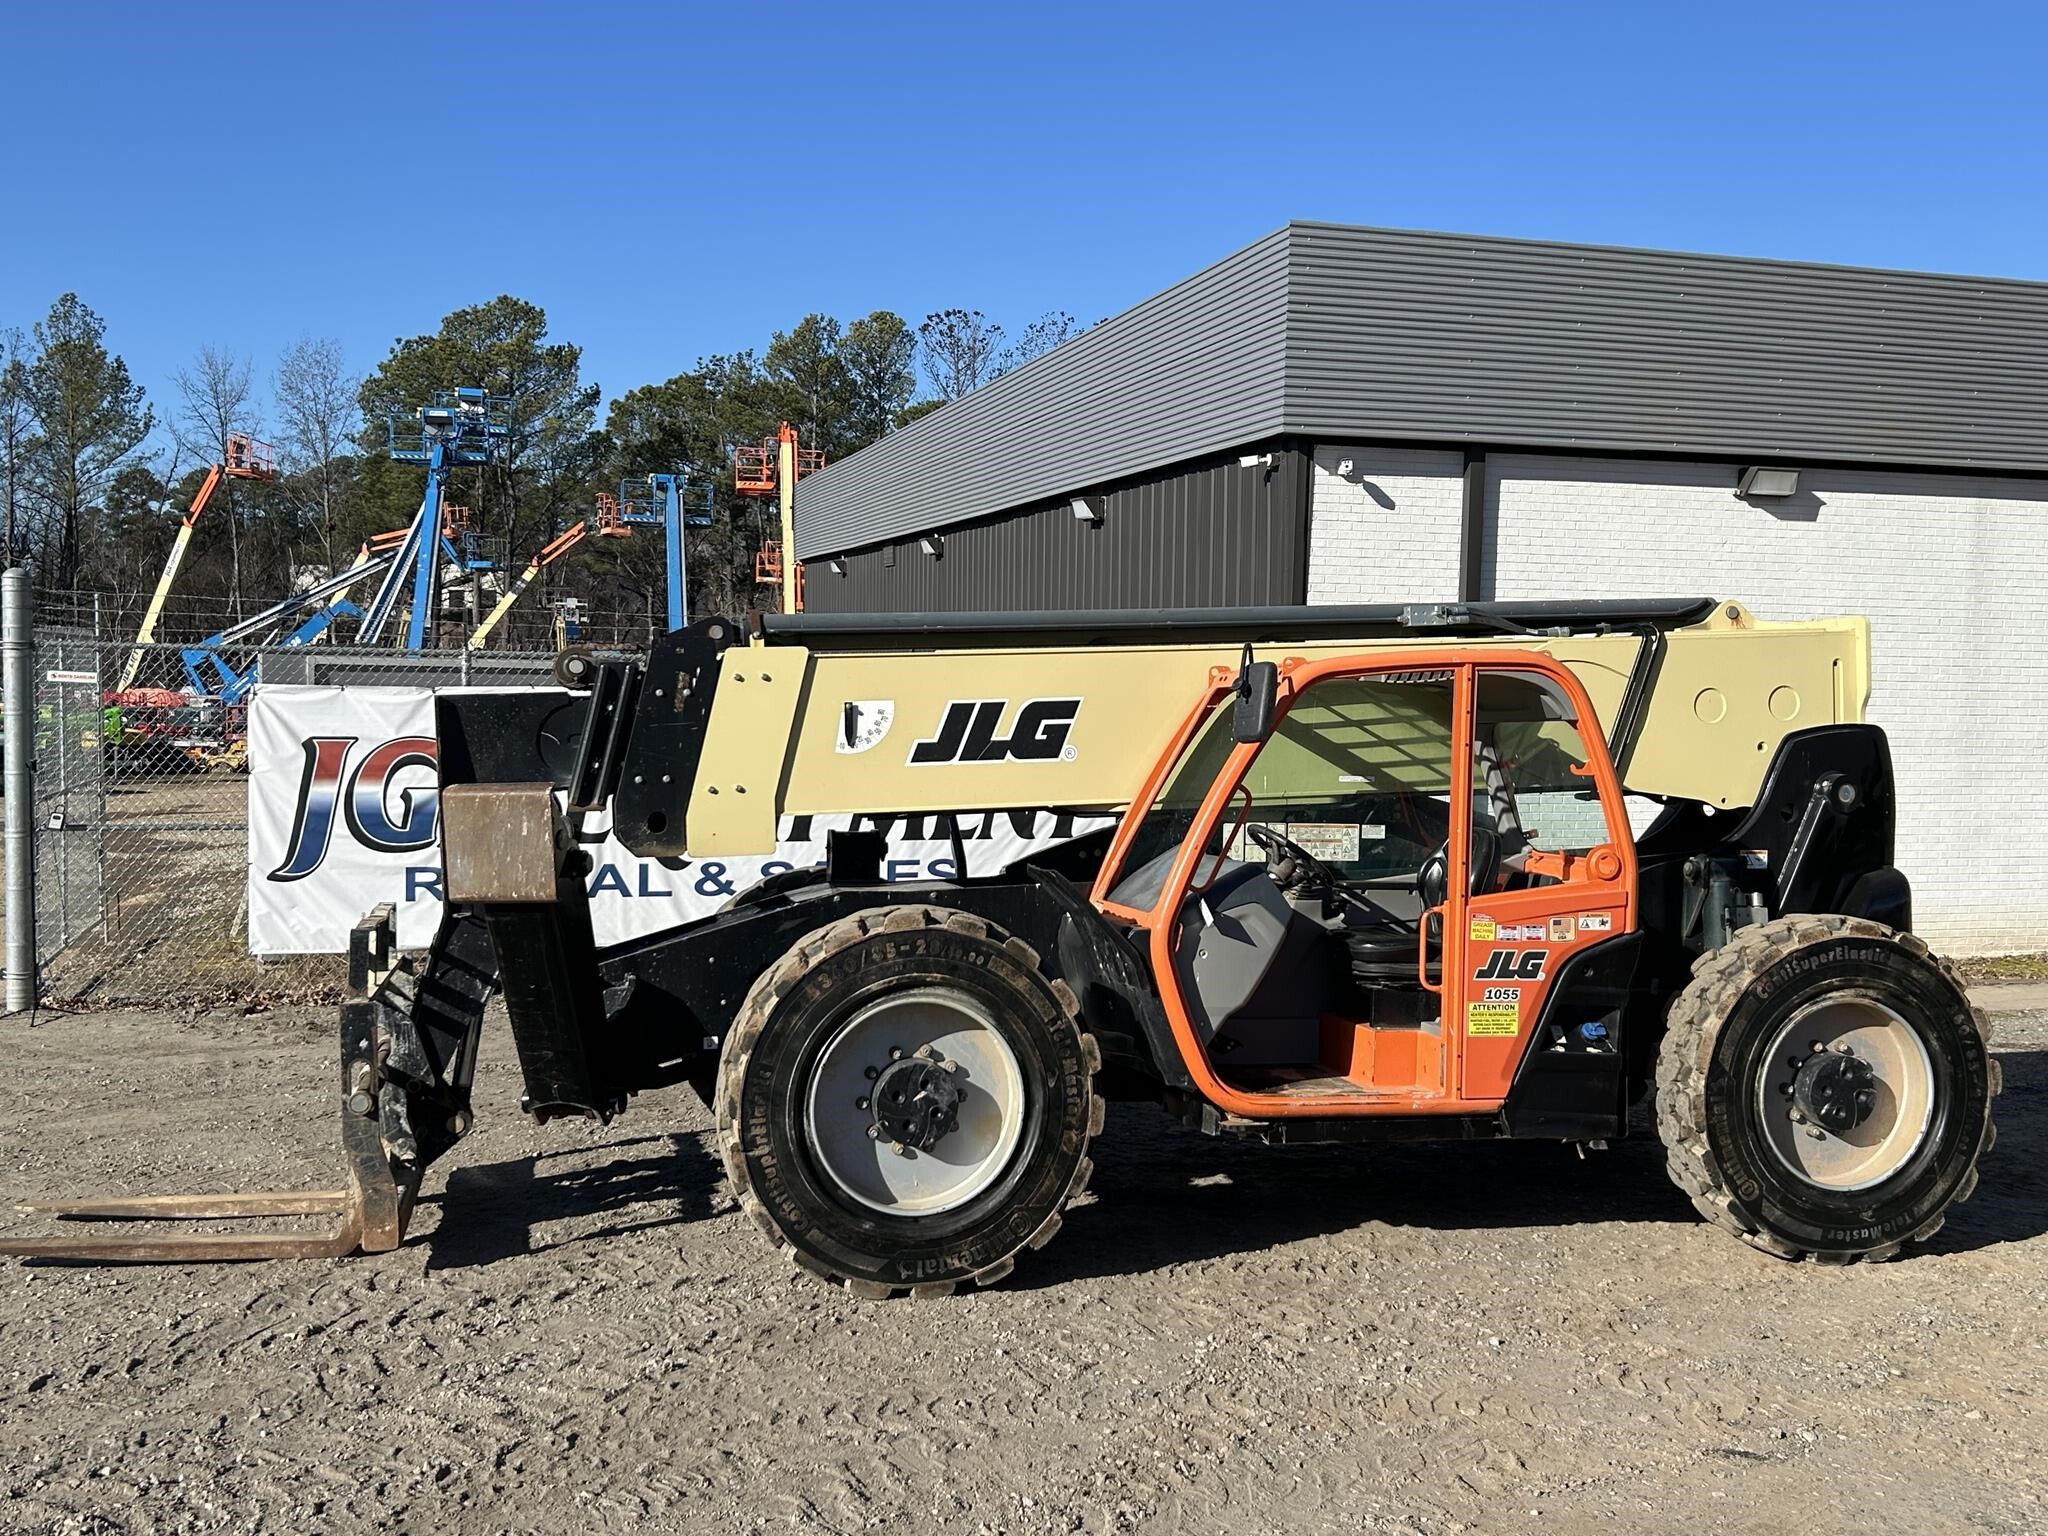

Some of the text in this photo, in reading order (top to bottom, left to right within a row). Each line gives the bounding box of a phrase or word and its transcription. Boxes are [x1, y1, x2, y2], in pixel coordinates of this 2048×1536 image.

[909, 699, 1082, 764] JLG
[694, 861, 737, 896] &
[1475, 951, 1548, 979] JLG
[1485, 989, 1519, 1000] 1055
